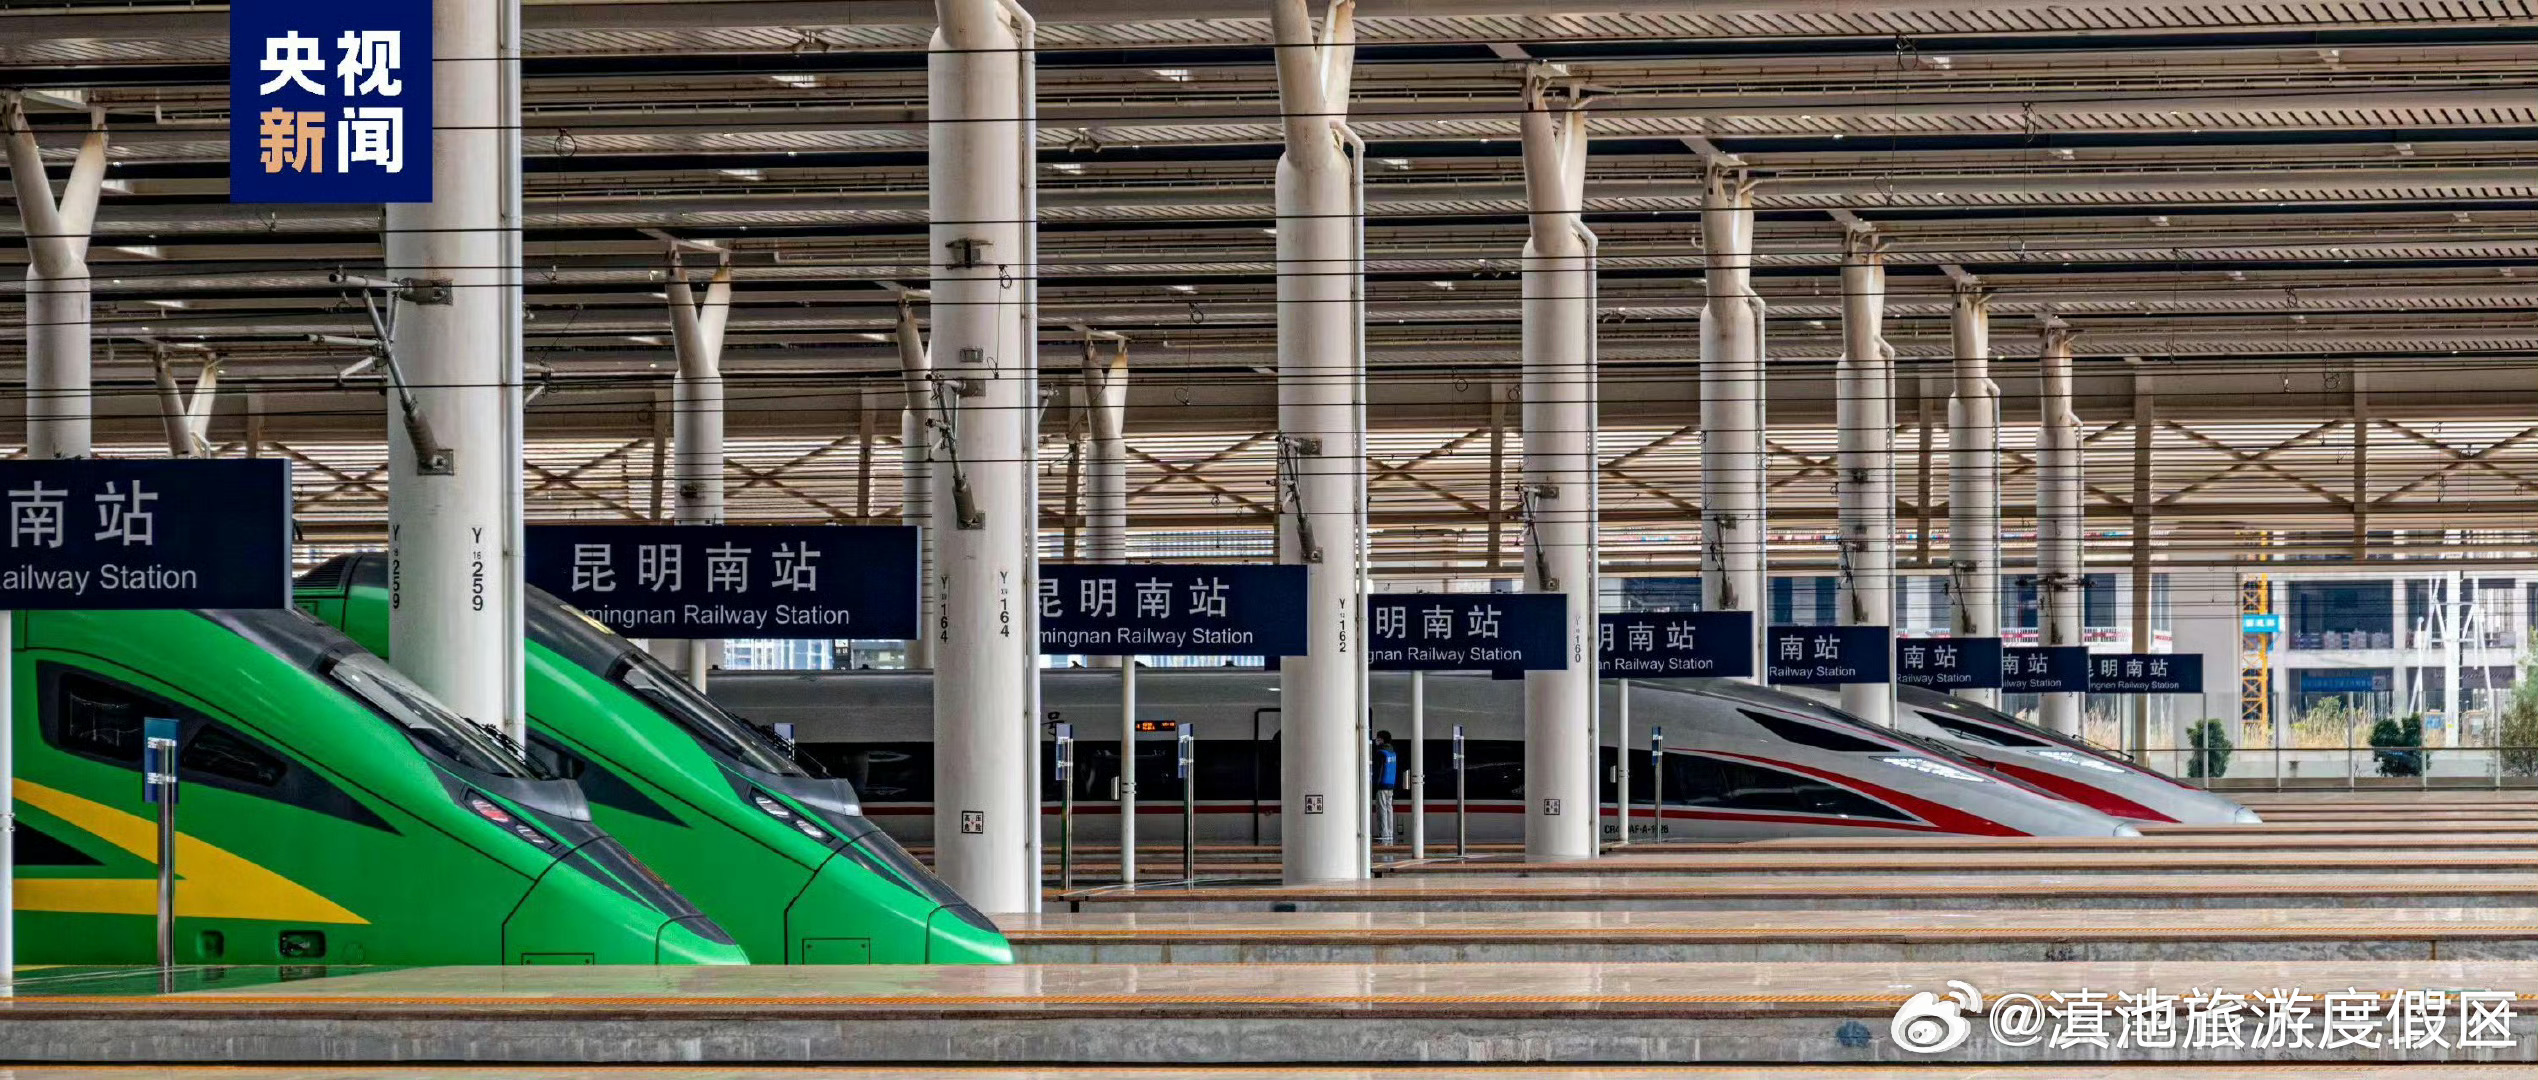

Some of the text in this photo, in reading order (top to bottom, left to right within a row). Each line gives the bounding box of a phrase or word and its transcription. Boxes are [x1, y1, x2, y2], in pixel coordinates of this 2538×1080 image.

[8, 480, 158, 549] 南站
[0, 564, 197, 595] ailway Station
[571, 541, 821, 593] 昆明南站
[472, 561, 484, 612] 259
[1039, 577, 1230, 618] 昆明南站
[685, 605, 768, 630] Railway
[776, 604, 849, 625] Station
[1376, 605, 1501, 640] 明南站
[1118, 628, 1187, 648] Railway
[1193, 628, 1253, 644] Station
[1780, 634, 1841, 661] 南站
[1408, 647, 1465, 665] Railway
[1470, 647, 1522, 661] Station
[1615, 658, 1665, 673] Railway
[1669, 658, 1713, 670] Station
[1904, 645, 1958, 669] 南站
[2003, 653, 2048, 675] 南站
[1769, 666, 1856, 679] Railway Station
[1937, 673, 1972, 683] Station
[2003, 679, 2062, 690] ilway Station
